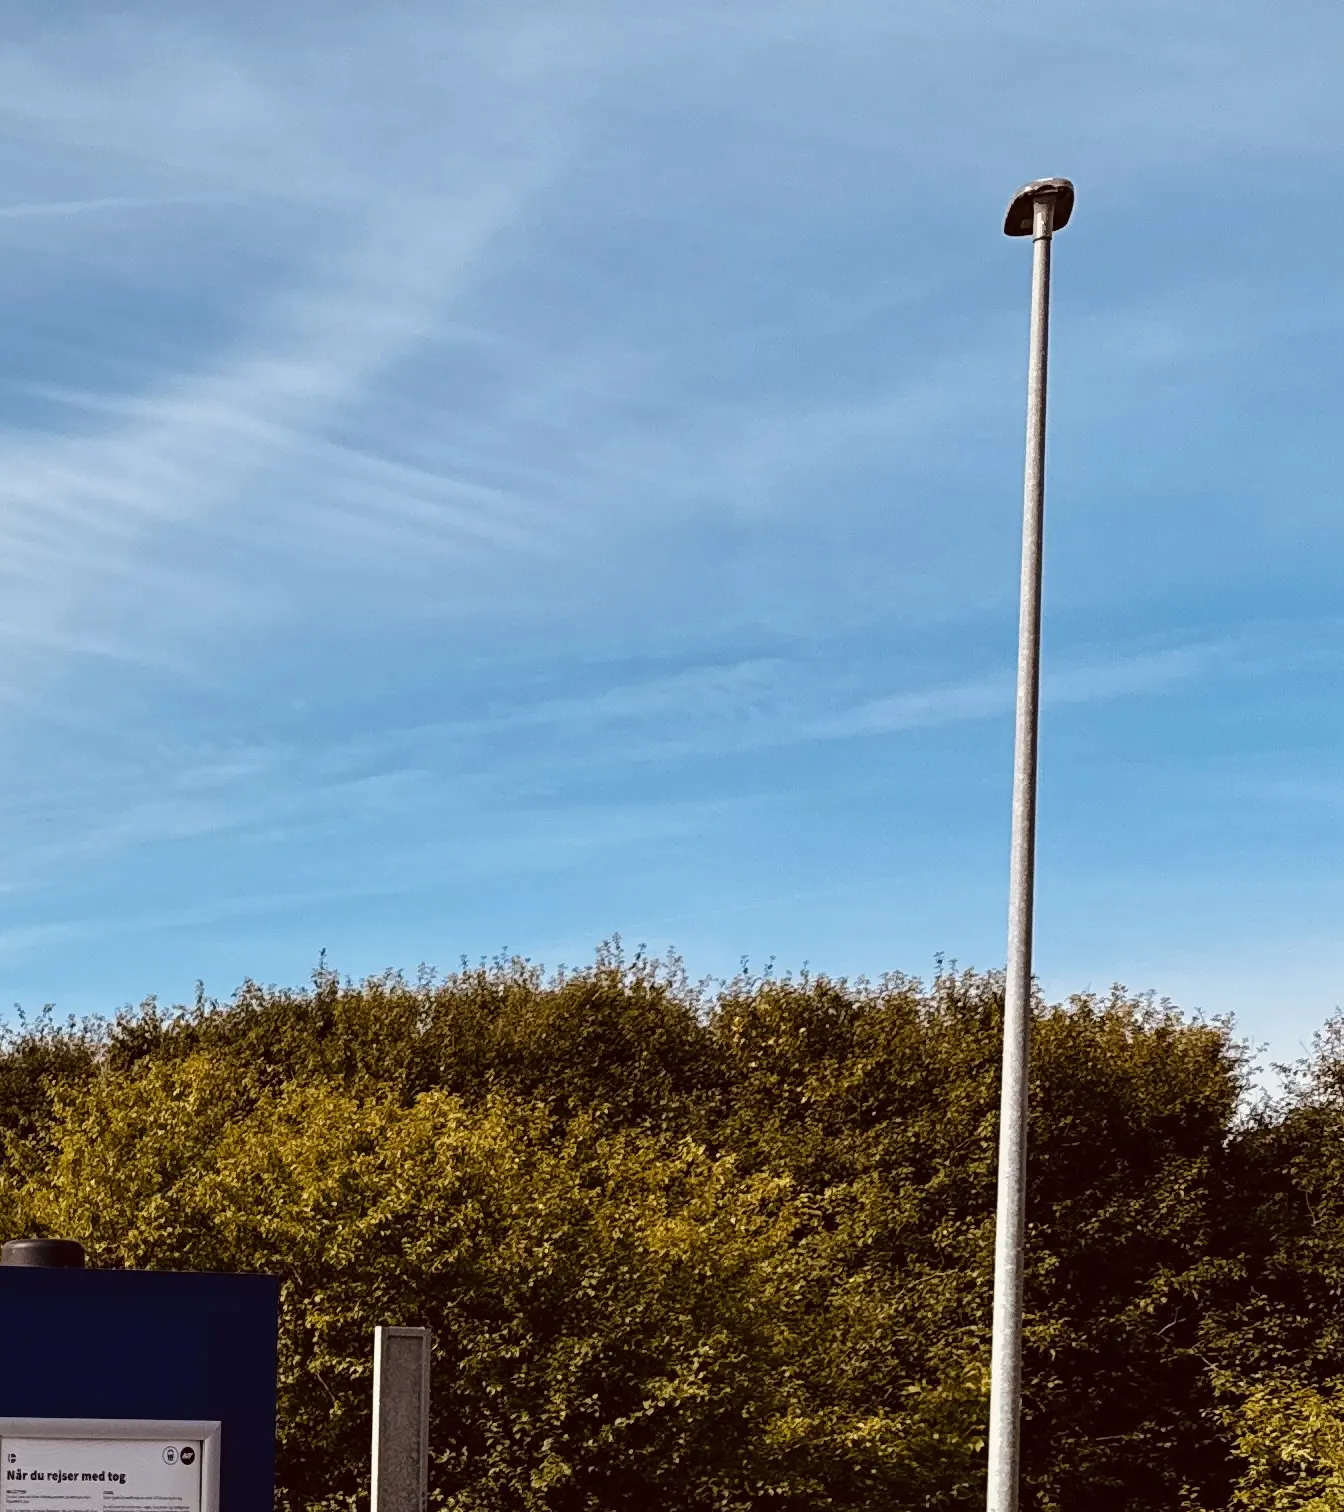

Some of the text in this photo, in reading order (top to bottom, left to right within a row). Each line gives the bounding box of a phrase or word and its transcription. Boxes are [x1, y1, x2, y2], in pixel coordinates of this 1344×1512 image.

[6, 1468, 127, 1485] Når du rejser med tog
